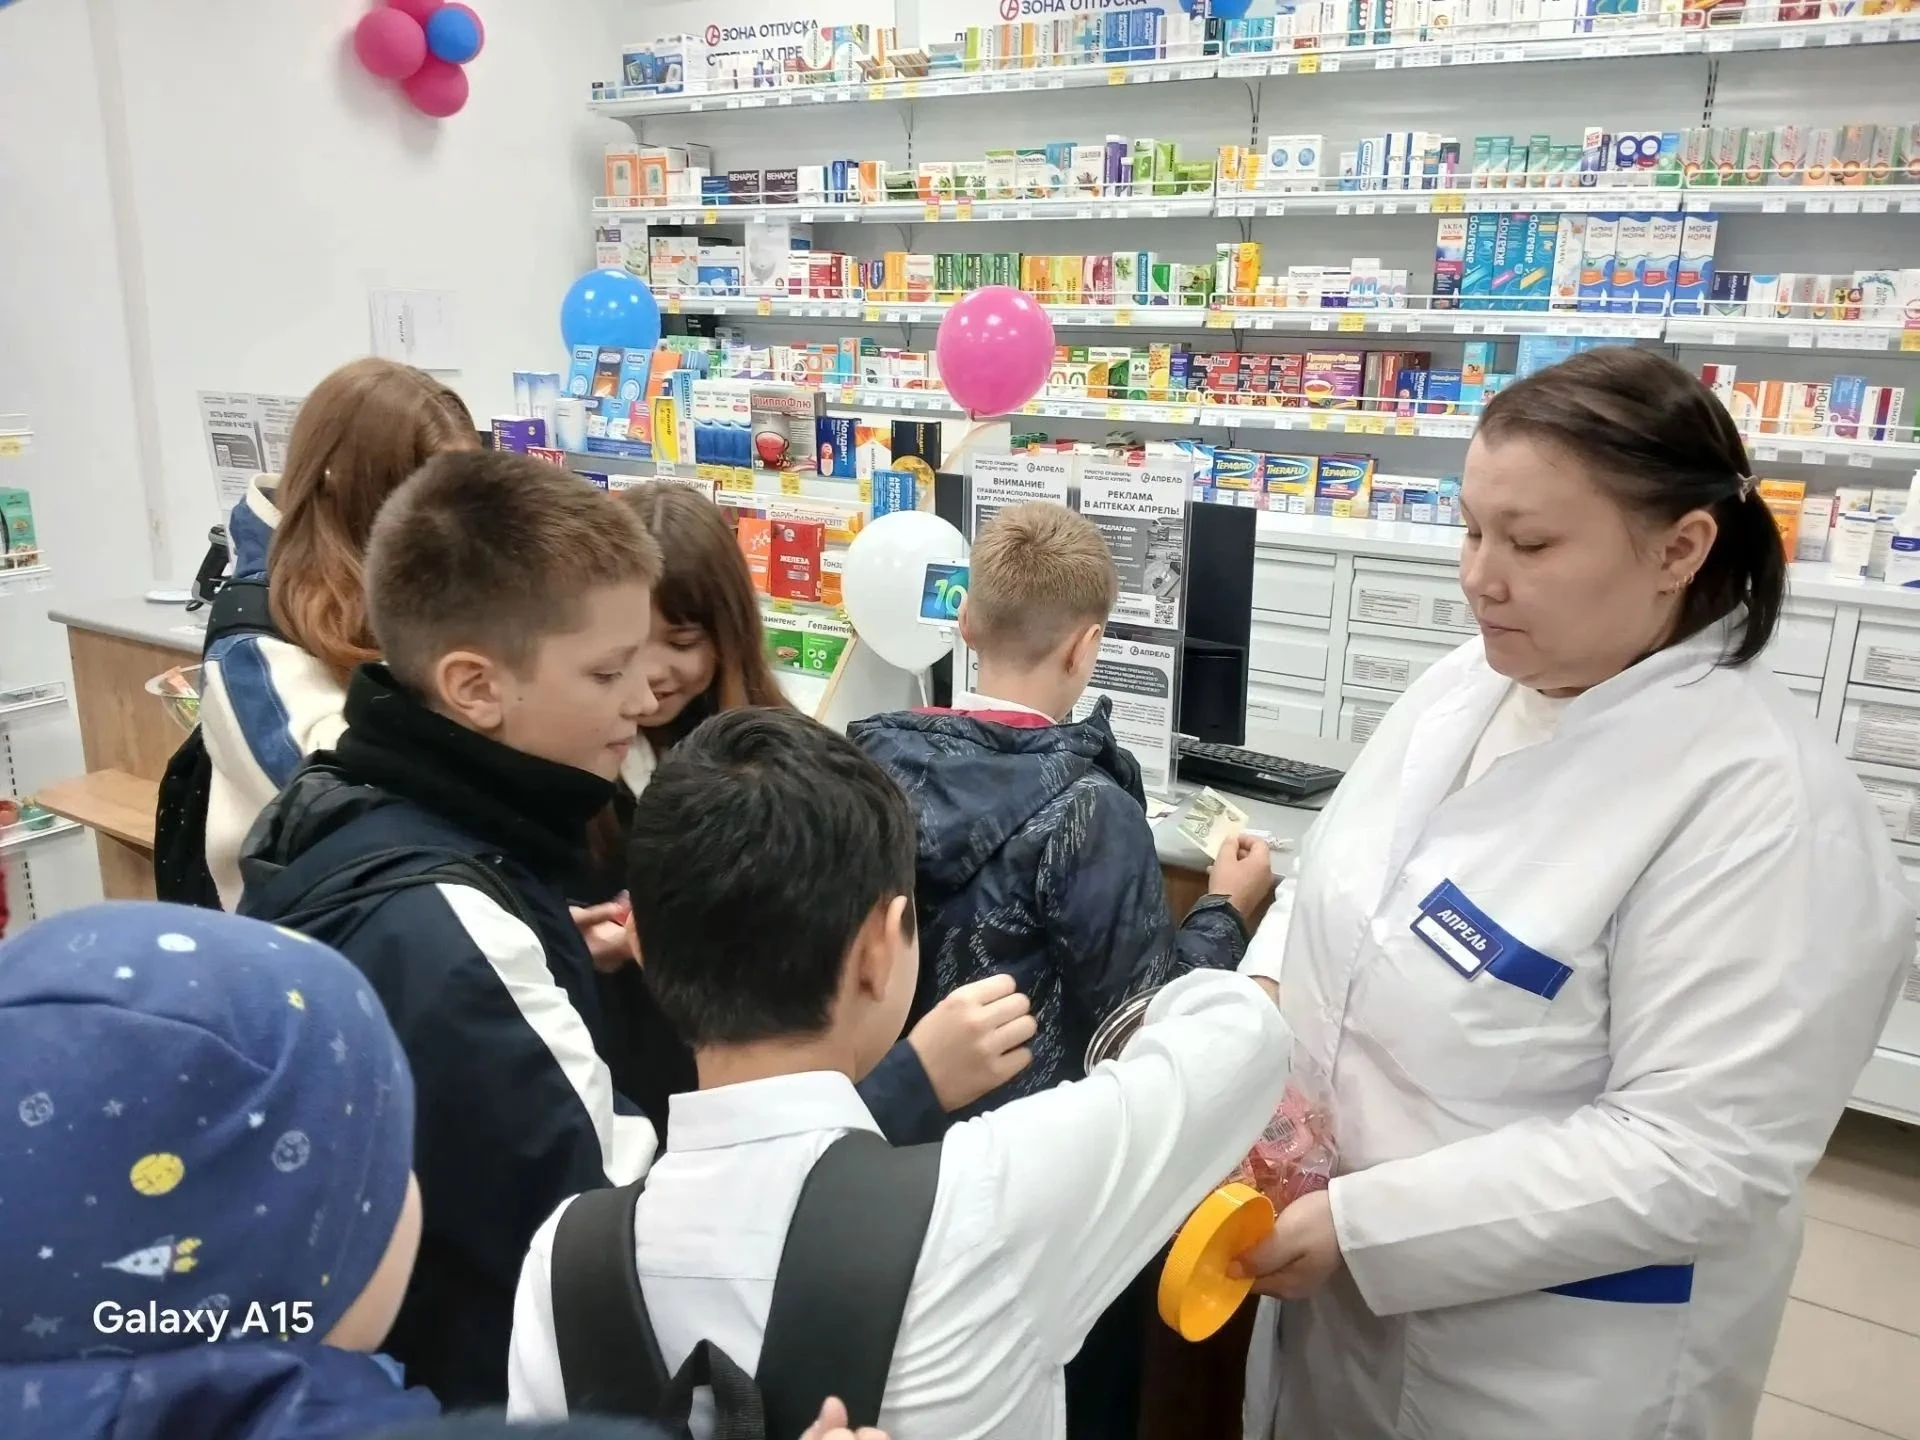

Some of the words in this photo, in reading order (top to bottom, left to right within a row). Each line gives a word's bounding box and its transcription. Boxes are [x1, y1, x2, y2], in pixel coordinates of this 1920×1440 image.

[722, 25, 756, 41] ЗОНА
[729, 173, 758, 182] ВЕНАРУС
[766, 172, 796, 181] ВЕНАРУС
[1465, 215, 1479, 264] аквалор
[1493, 217, 1510, 266] аквалор
[1524, 214, 1539, 264] аквалор
[1036, 465, 1065, 473] АПРЕЛЬ
[1266, 464, 1305, 475] THERAFLU
[1321, 466, 1360, 478] ТЕРАФЛЮ
[993, 477, 1045, 489] ВНИМАНИЕ!
[1151, 475, 1183, 484] АПРЕЛЬ
[977, 487, 1005, 495] ПРАВИЛА
[1006, 488, 1061, 499] ИСПОЛЬЗОВАНИЯ
[1107, 490, 1154, 502] РЕКЛАМА
[1084, 500, 1091, 508] В
[1093, 501, 1136, 512] АПТЕКАХ
[1138, 504, 1180, 515] АПРЕЛЬ!
[934, 579, 968, 617] 10
[762, 615, 797, 627] аинтенс
[1140, 649, 1171, 659] АПРЕЛЬ
[1437, 908, 1489, 952] АПРЕЛЬ
